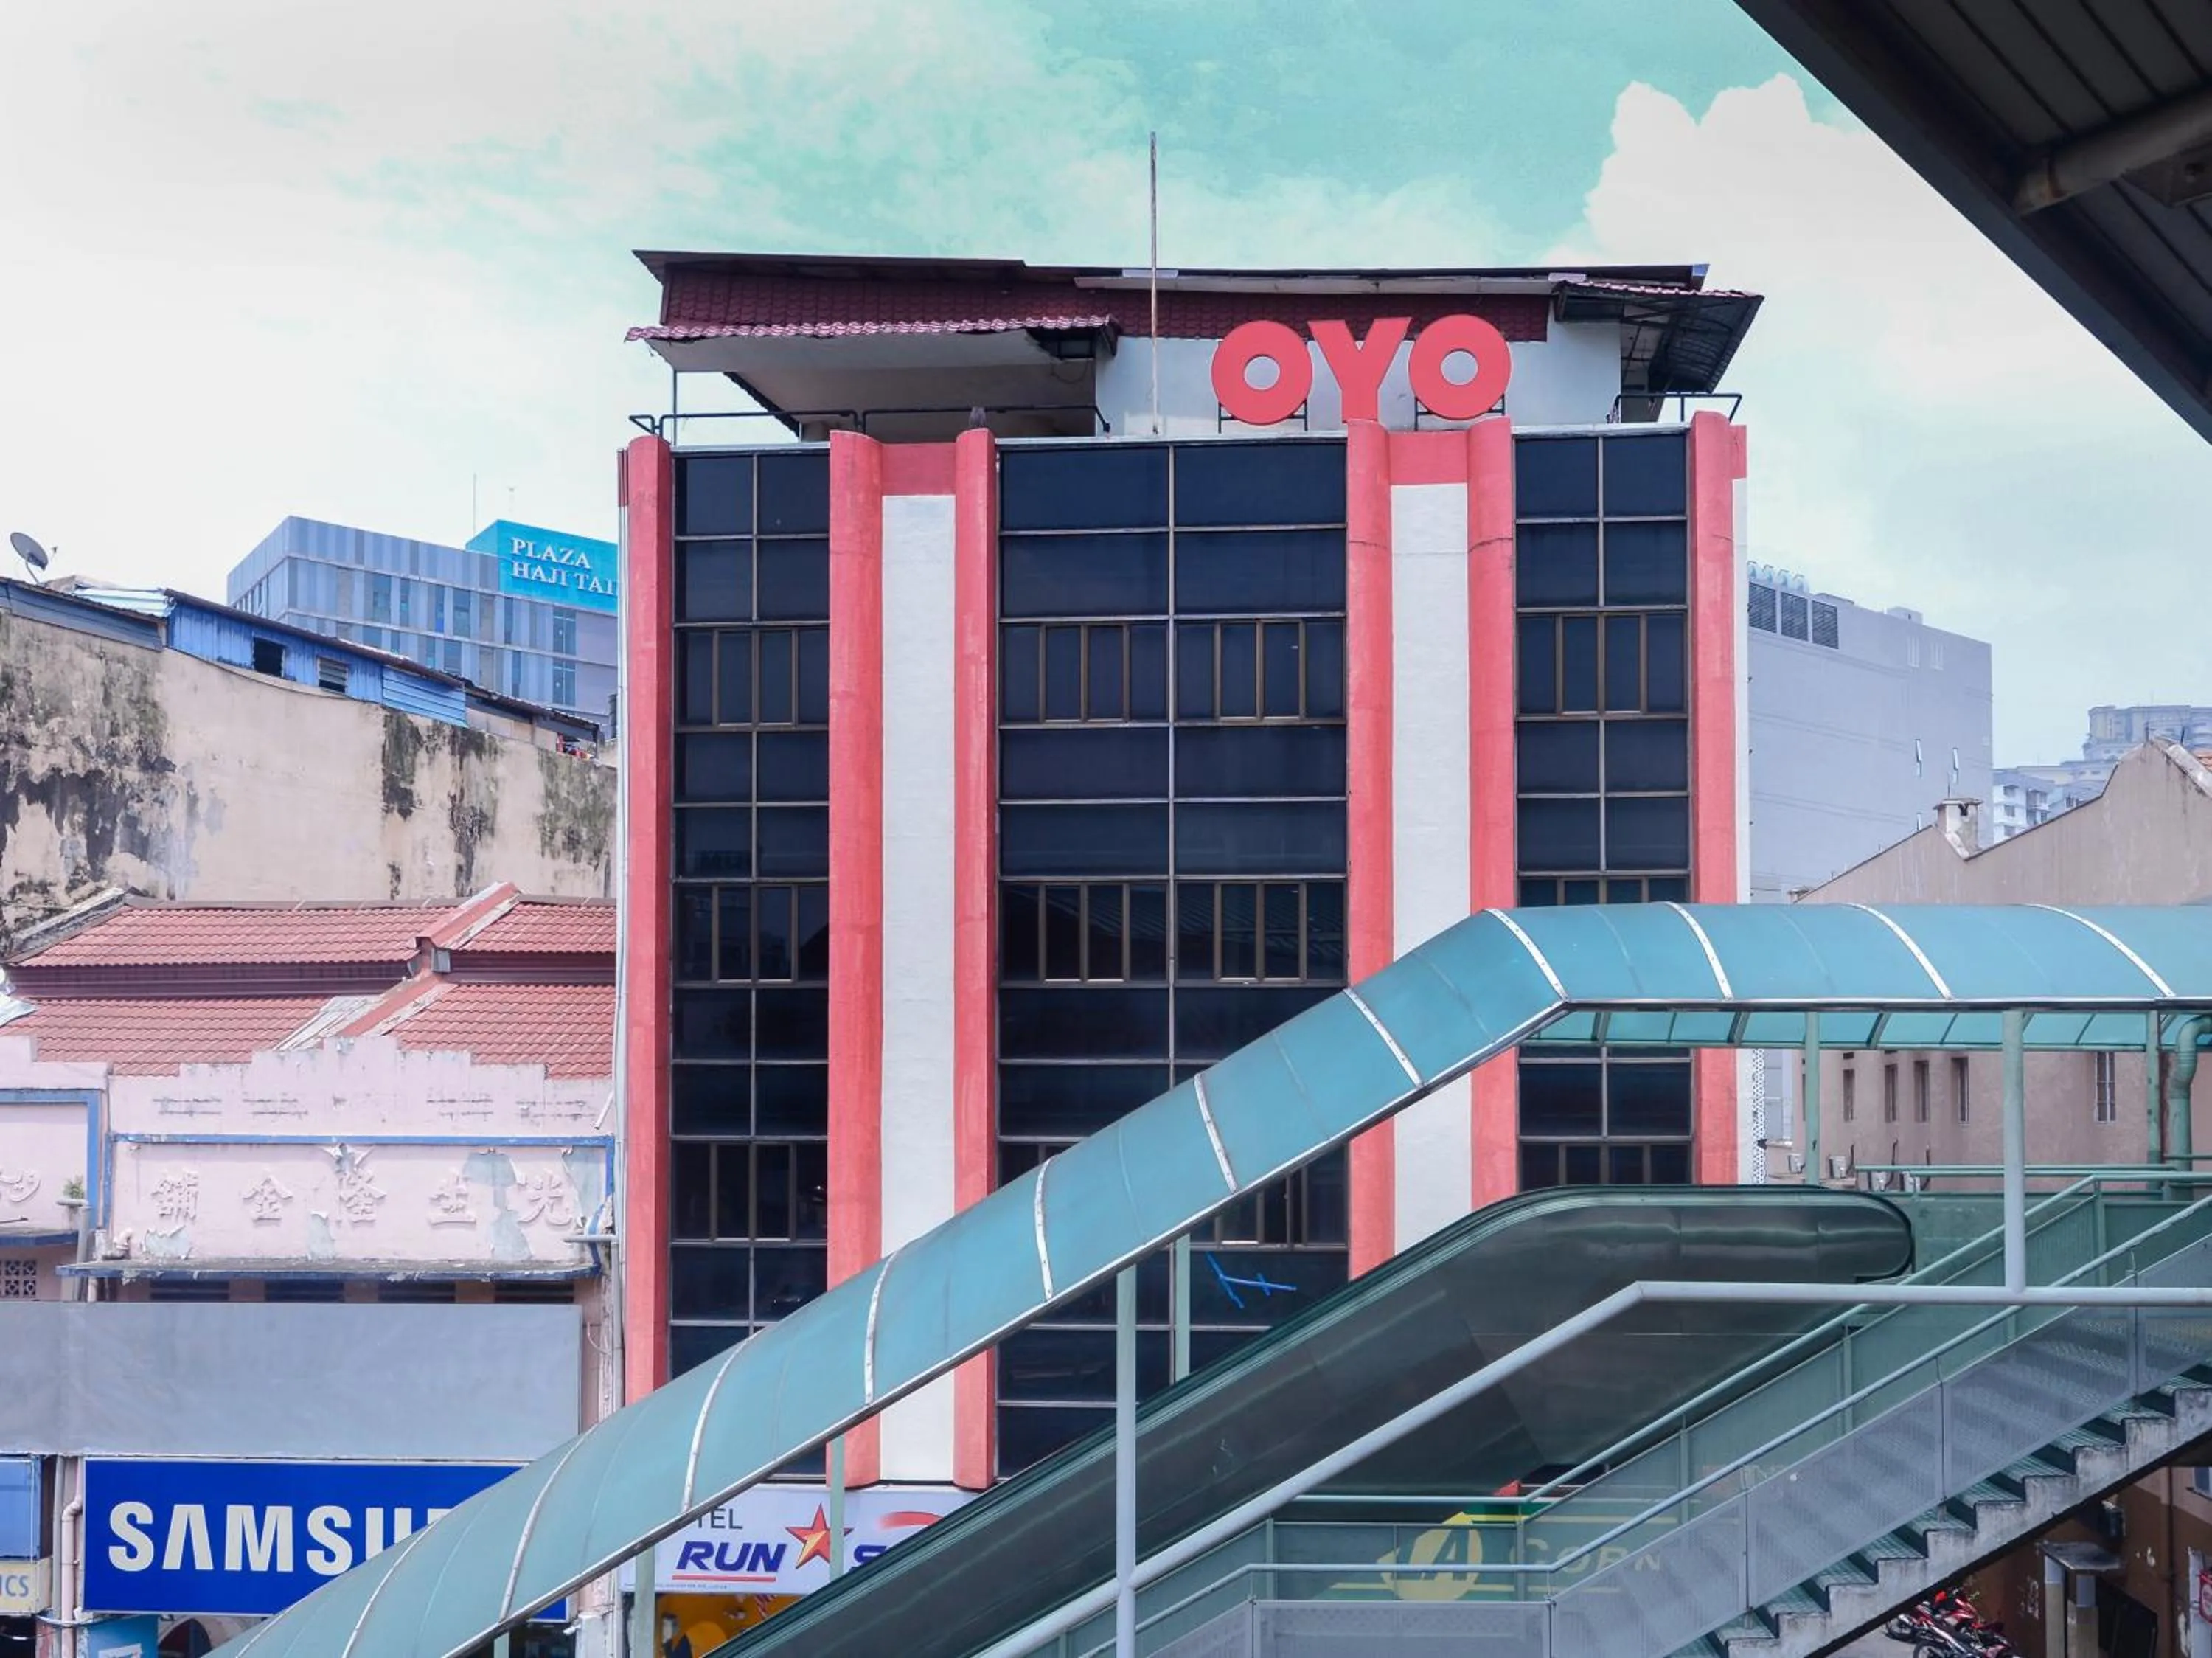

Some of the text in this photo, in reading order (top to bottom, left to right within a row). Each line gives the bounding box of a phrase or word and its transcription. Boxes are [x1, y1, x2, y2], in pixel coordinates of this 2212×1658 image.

[1211, 313, 1512, 425] OYO
[510, 536, 592, 569] PLAZA
[512, 561, 568, 586] HAJI
[108, 1501, 453, 1576] SAMSU
[676, 1541, 787, 1572] RUN
